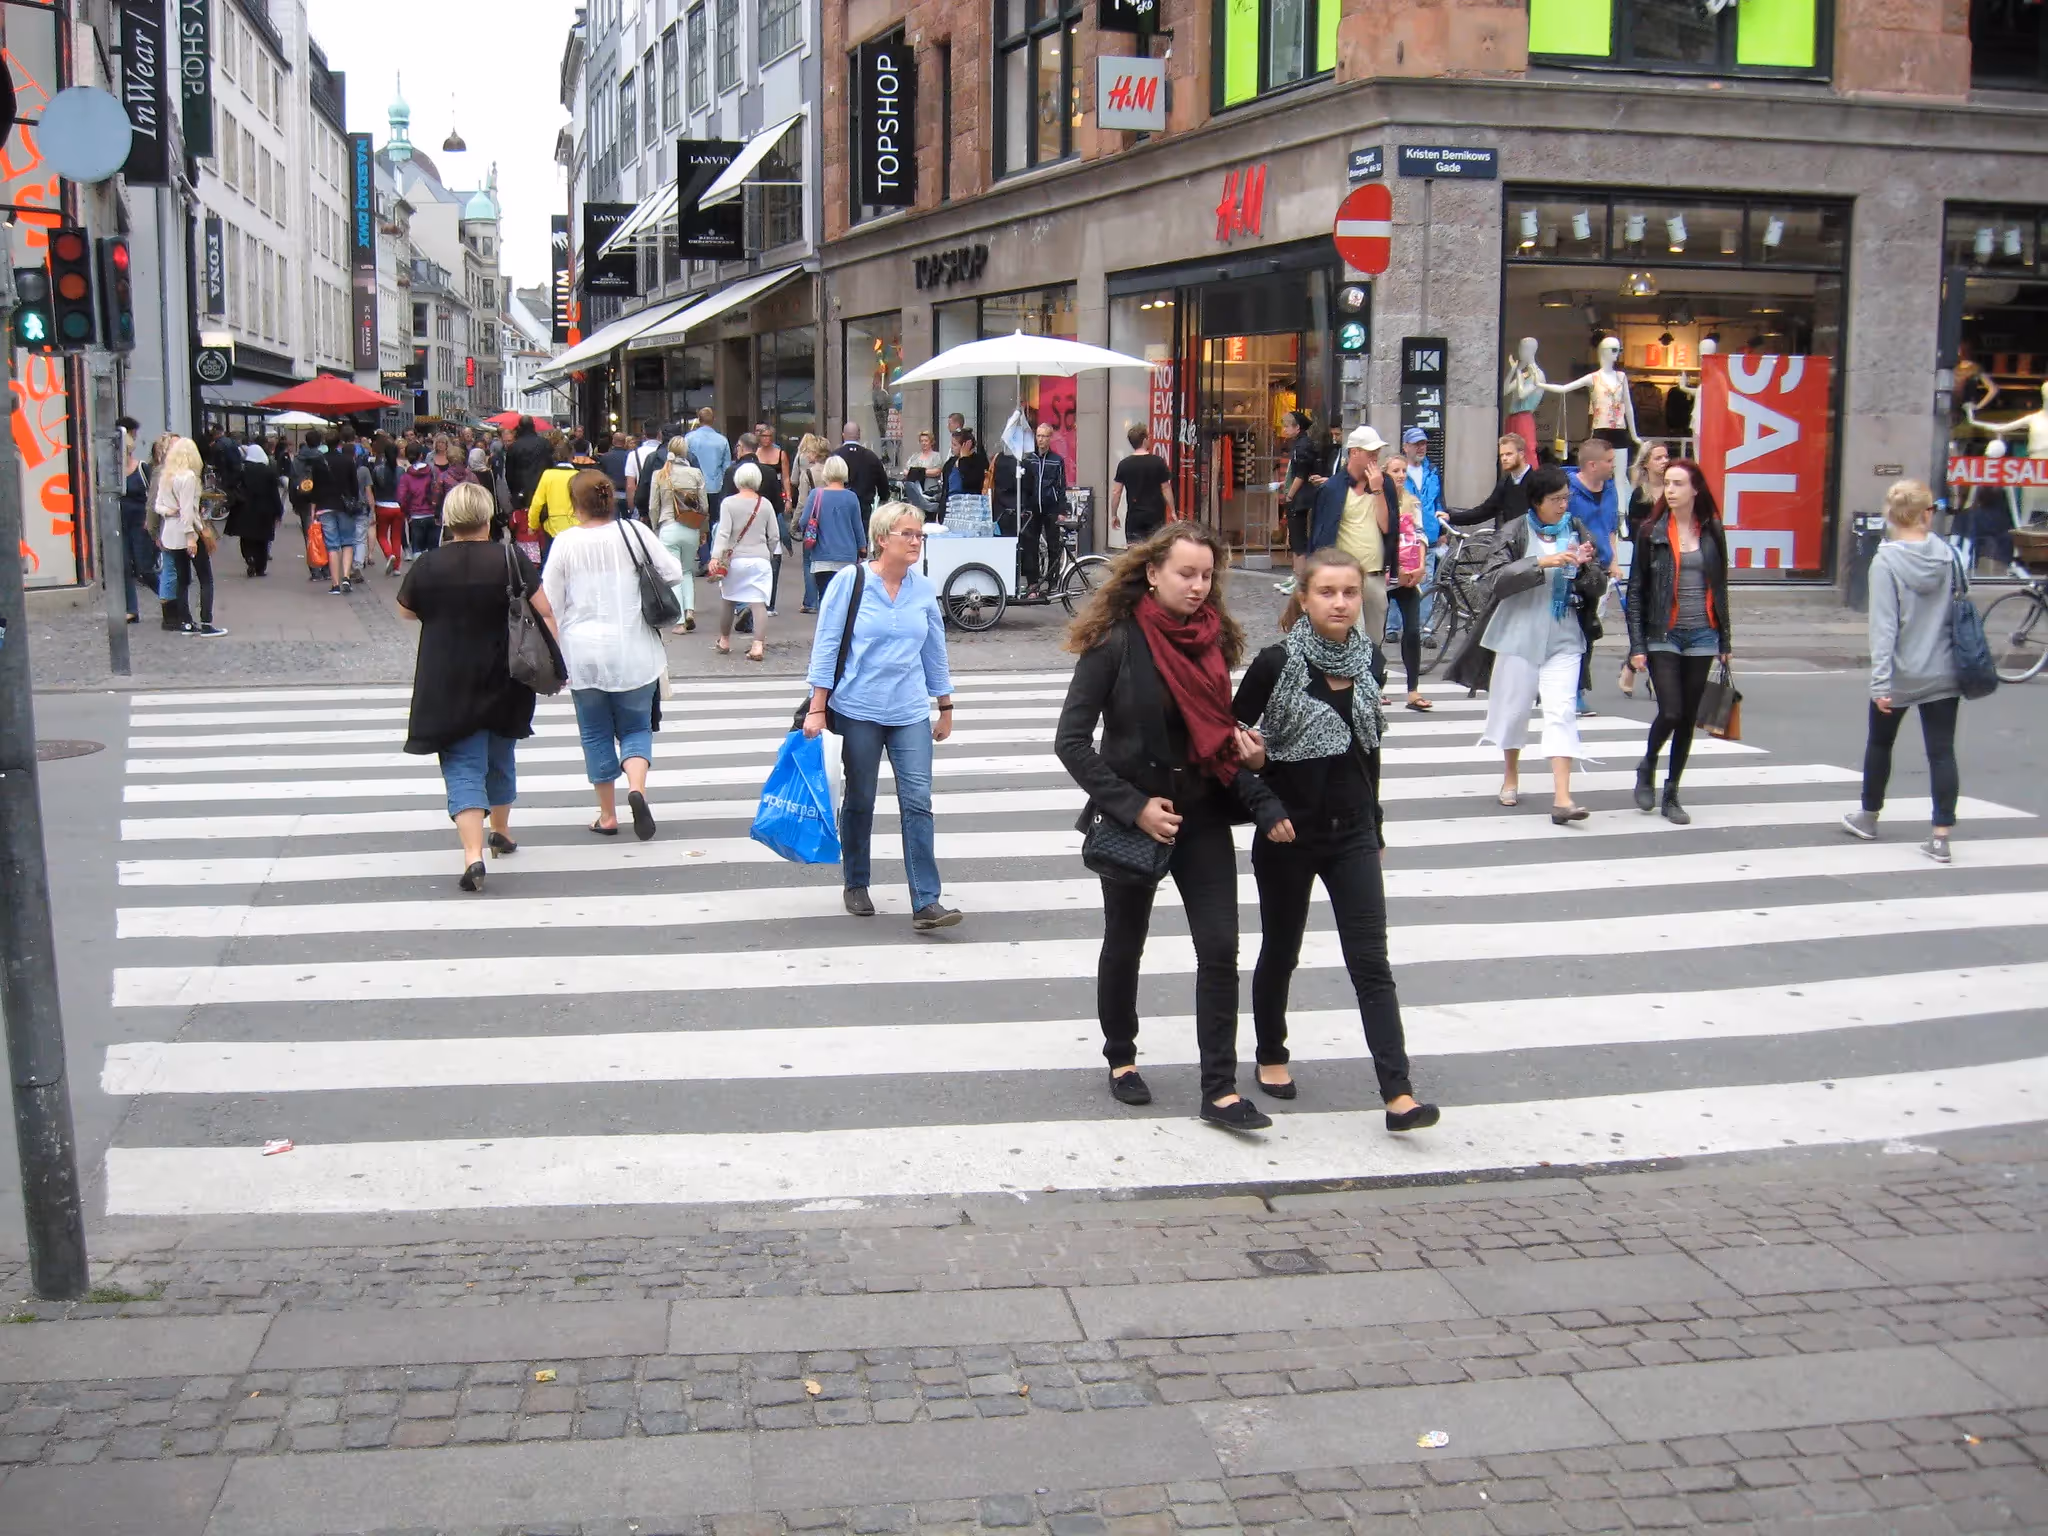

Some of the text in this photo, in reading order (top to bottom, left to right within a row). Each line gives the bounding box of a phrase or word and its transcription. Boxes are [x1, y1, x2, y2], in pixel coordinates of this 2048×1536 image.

[126, 28, 157, 141] InWear
[182, 22, 205, 95] SHOP
[876, 54, 899, 194] TOPSHOP
[1108, 75, 1158, 113] H&M
[355, 138, 370, 211] NASDAQ
[690, 155, 731, 165] LANVIN
[1406, 148, 1440, 160] Kristen
[1435, 161, 1461, 173] Gade
[593, 215, 627, 223] LANVIN
[209, 233, 220, 299] FONA
[1723, 355, 1805, 568] SALE
